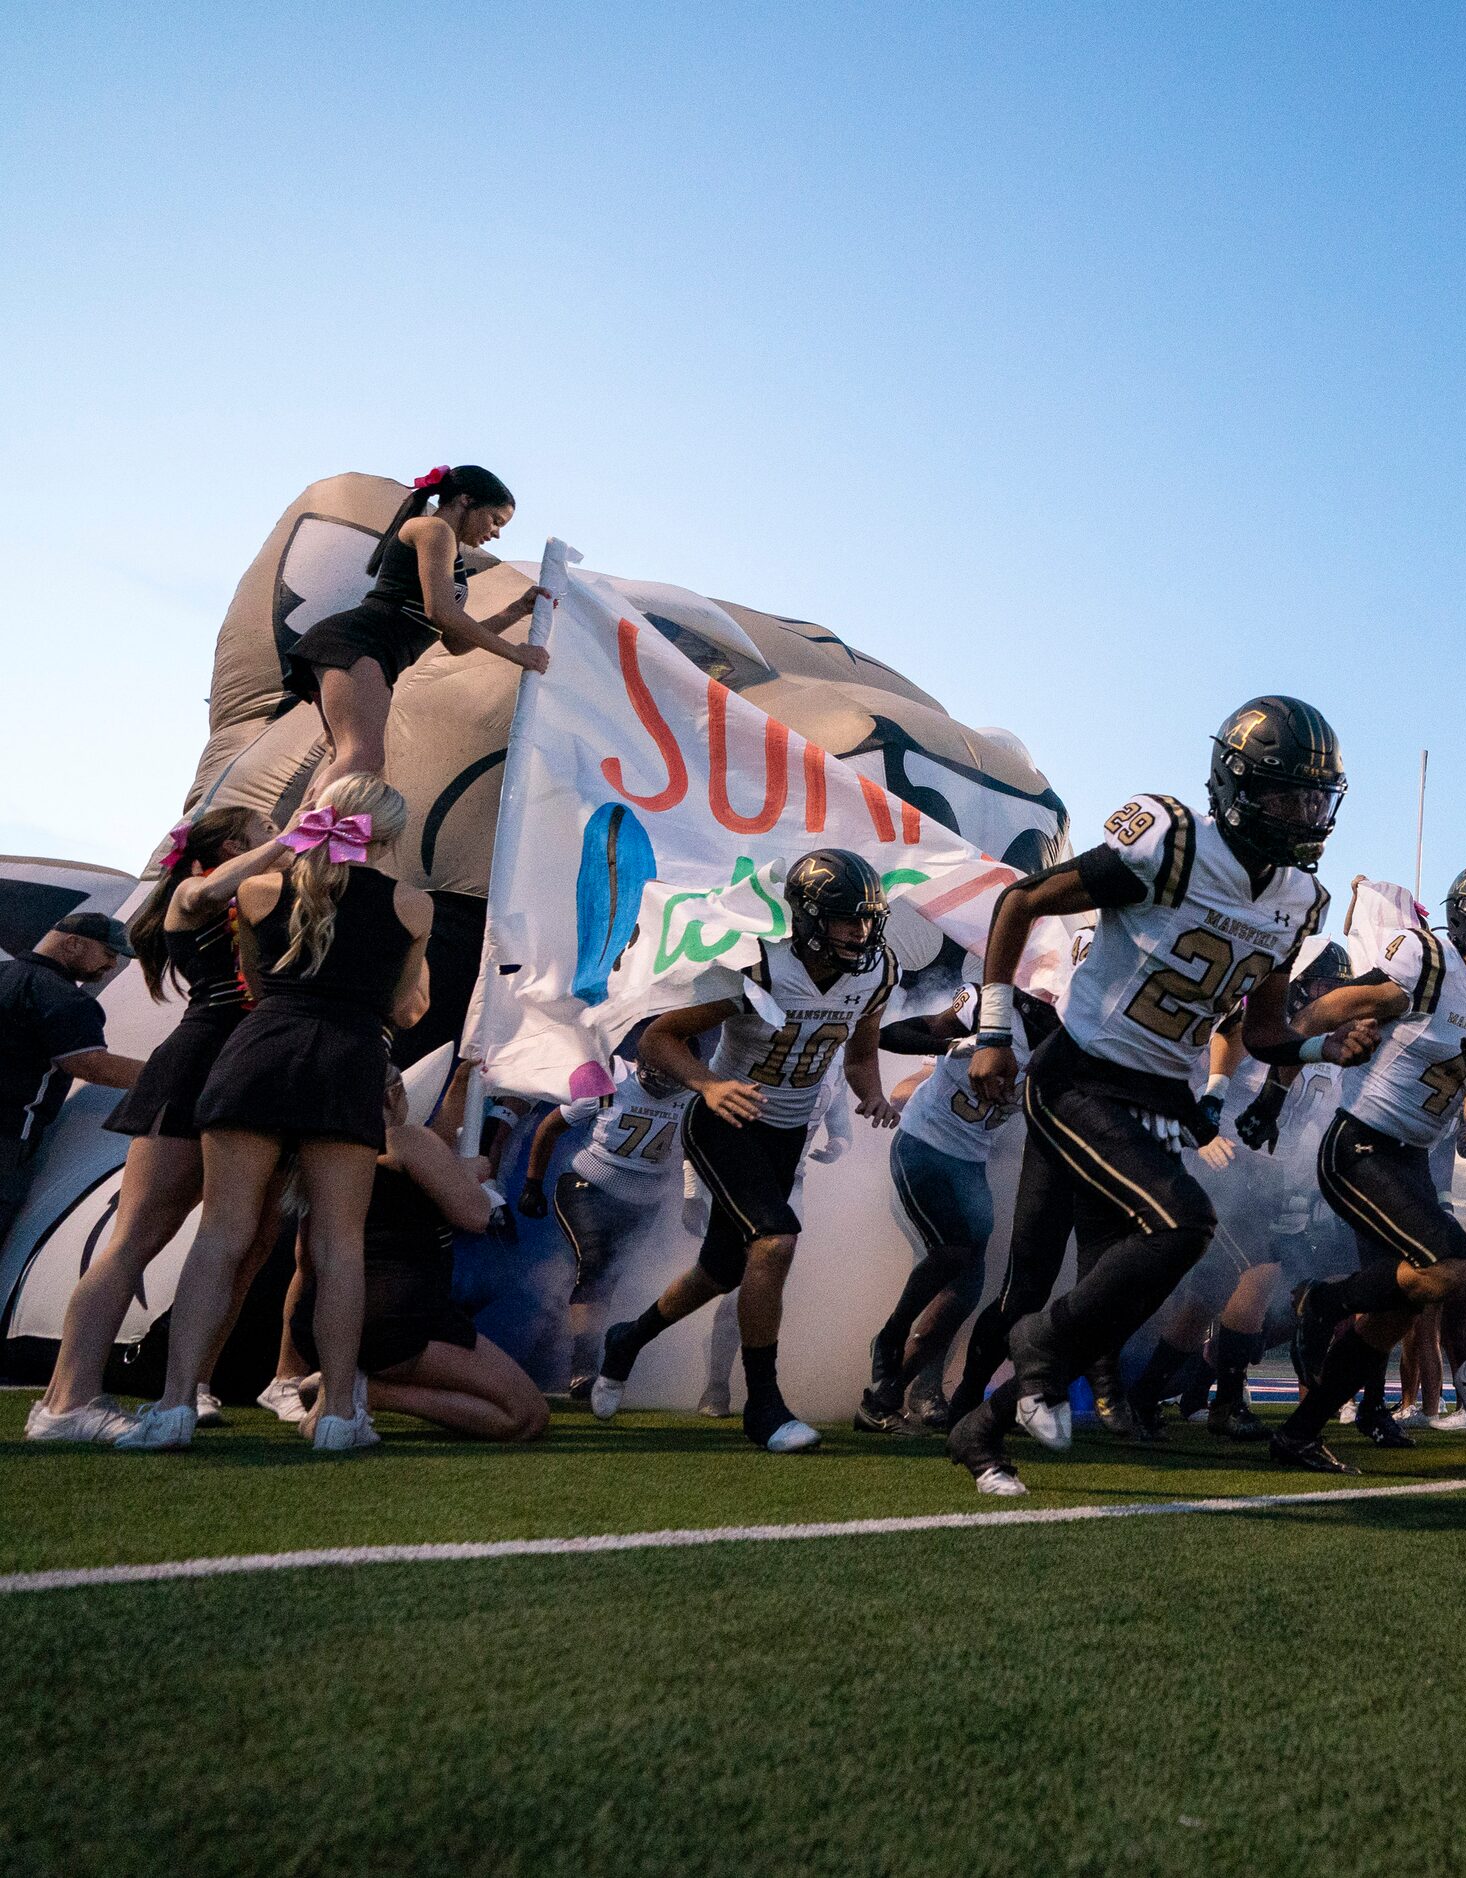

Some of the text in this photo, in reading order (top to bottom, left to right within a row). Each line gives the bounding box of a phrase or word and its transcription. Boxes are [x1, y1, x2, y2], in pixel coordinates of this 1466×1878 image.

[1104, 802, 1155, 846] 29
[790, 858, 835, 900] M
[1204, 909, 1279, 949] MANSFIELD
[1385, 935, 1406, 961] 4
[785, 1009, 855, 1020] MANSFIELD
[747, 1022, 849, 1089] 10
[608, 1113, 679, 1164] 74
